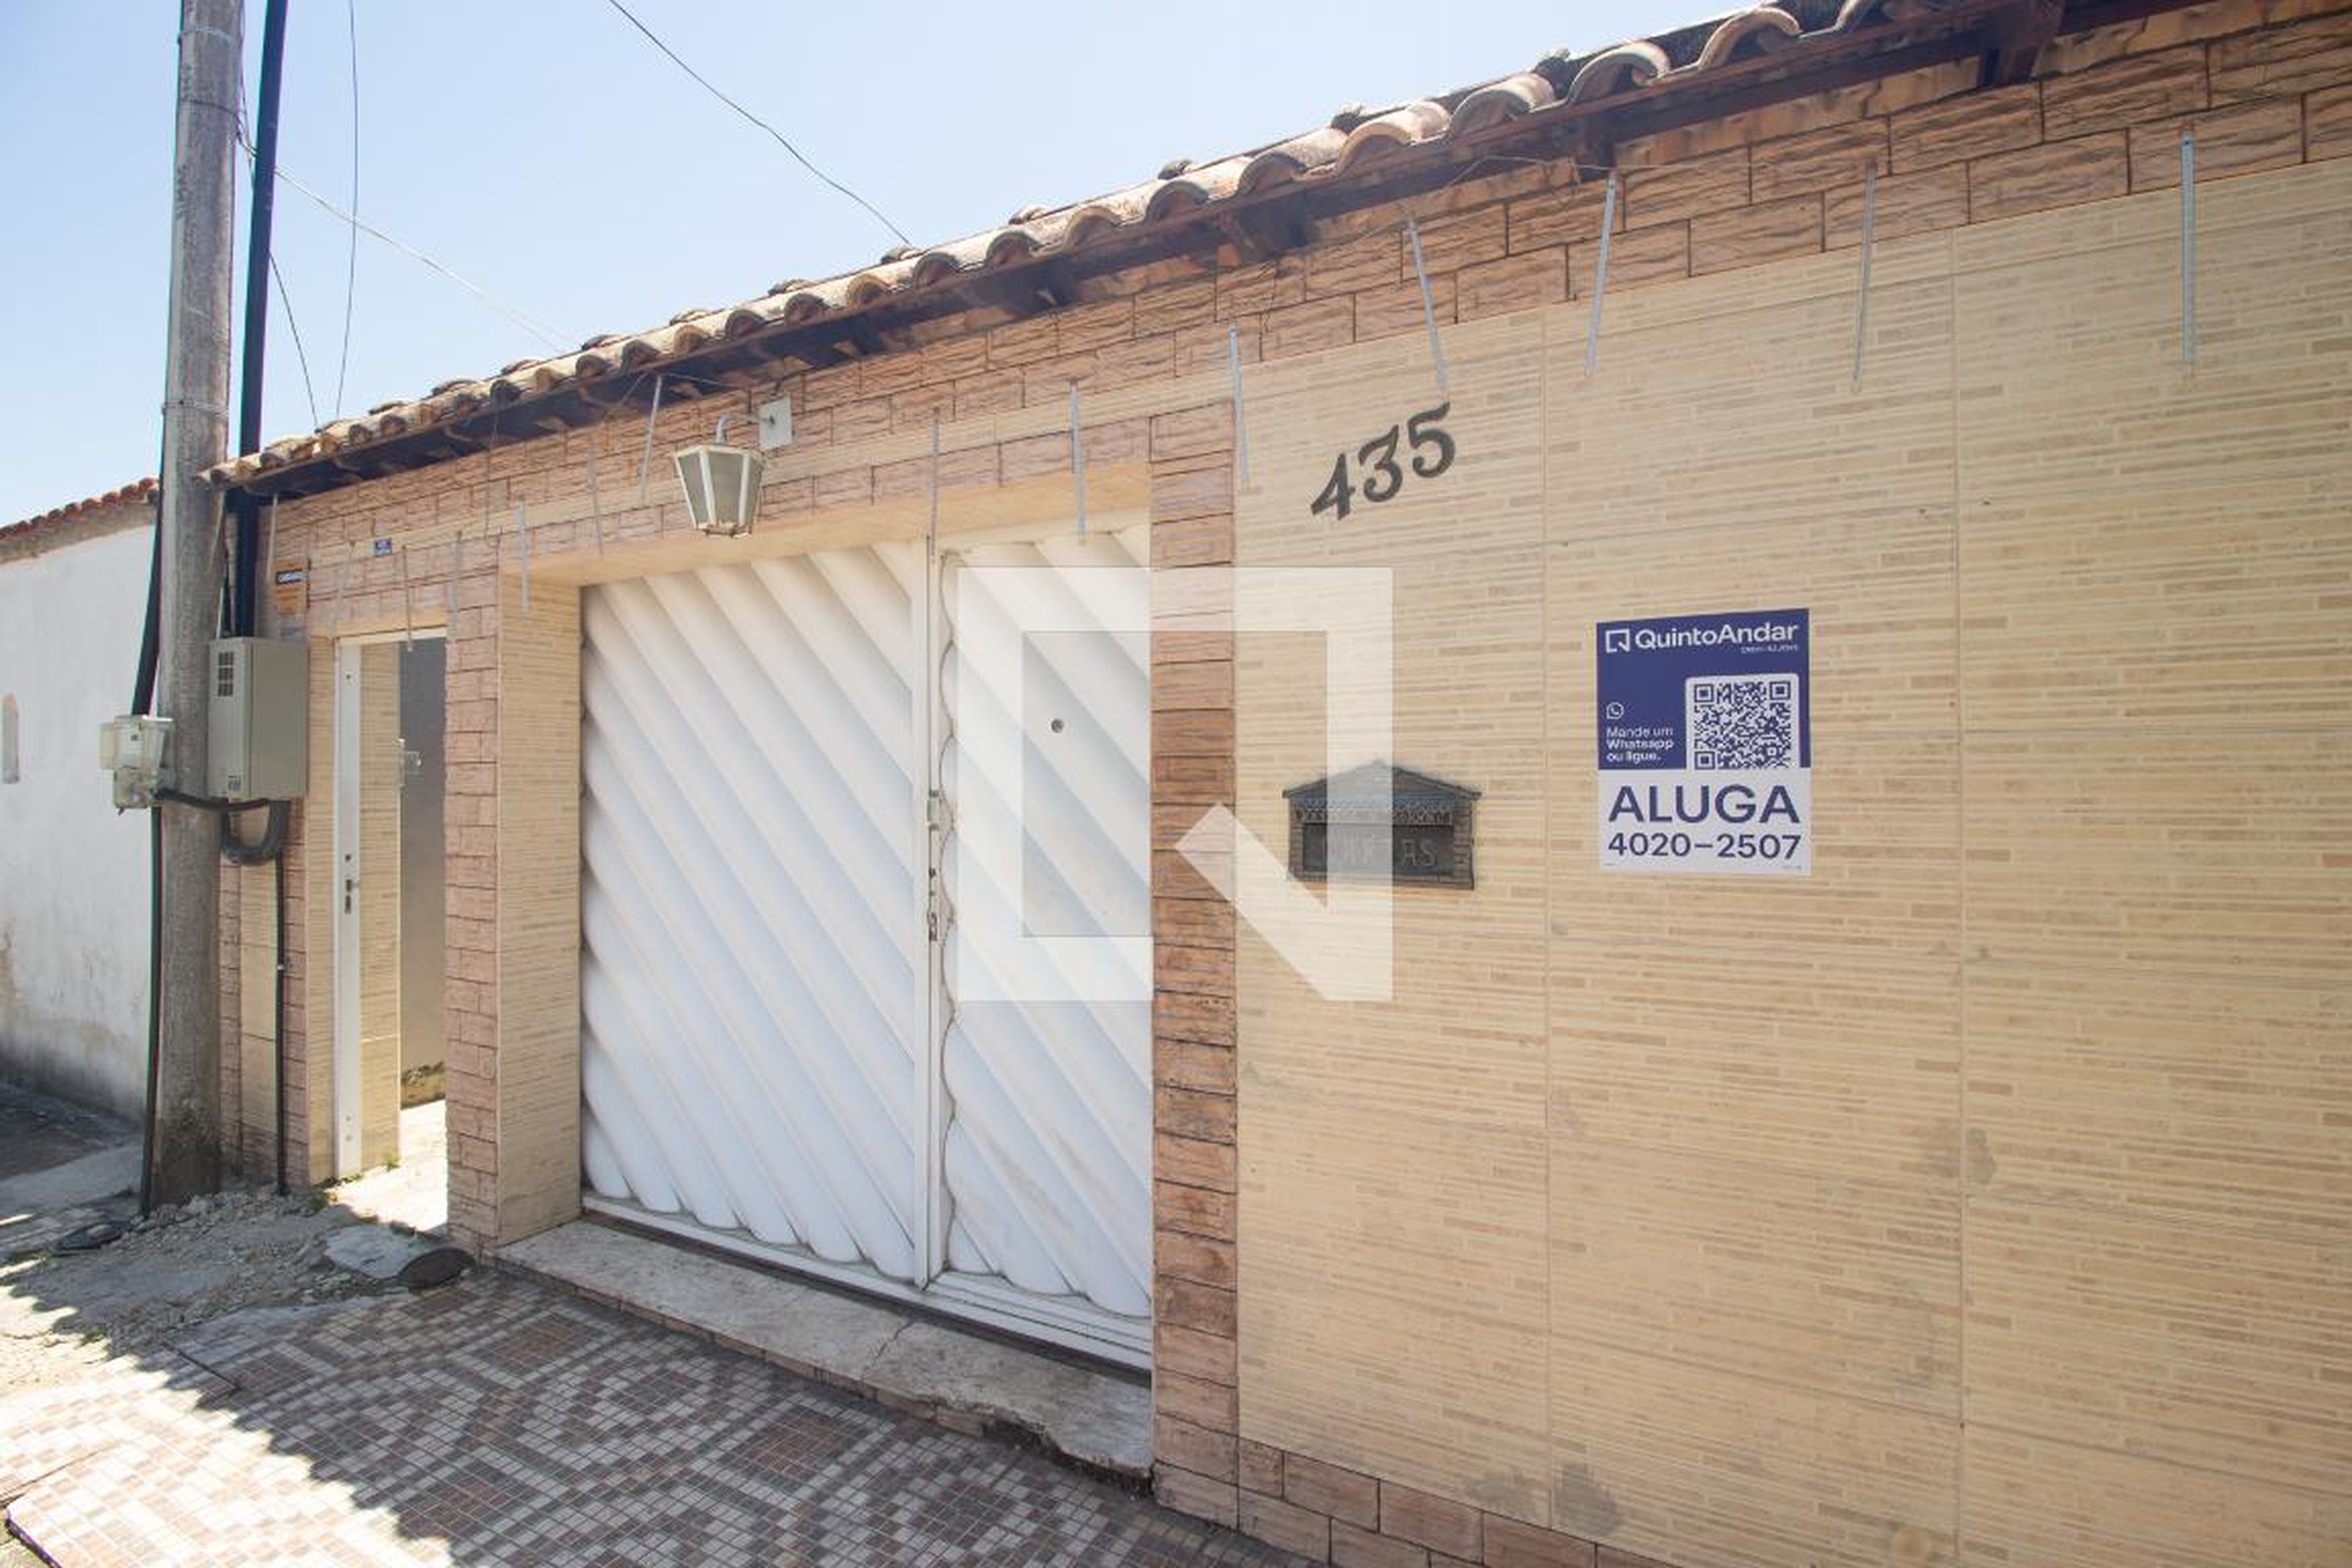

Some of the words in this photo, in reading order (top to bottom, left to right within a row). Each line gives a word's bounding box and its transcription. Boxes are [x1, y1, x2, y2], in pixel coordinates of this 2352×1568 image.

[1311, 402, 1455, 520] 435
[1635, 622, 1798, 649] QuintoAndar
[1606, 726, 1651, 737] Mande
[1653, 728, 1673, 736] um
[1608, 784, 1800, 824] ALUGA
[1608, 832, 1802, 859] 4020-2507
